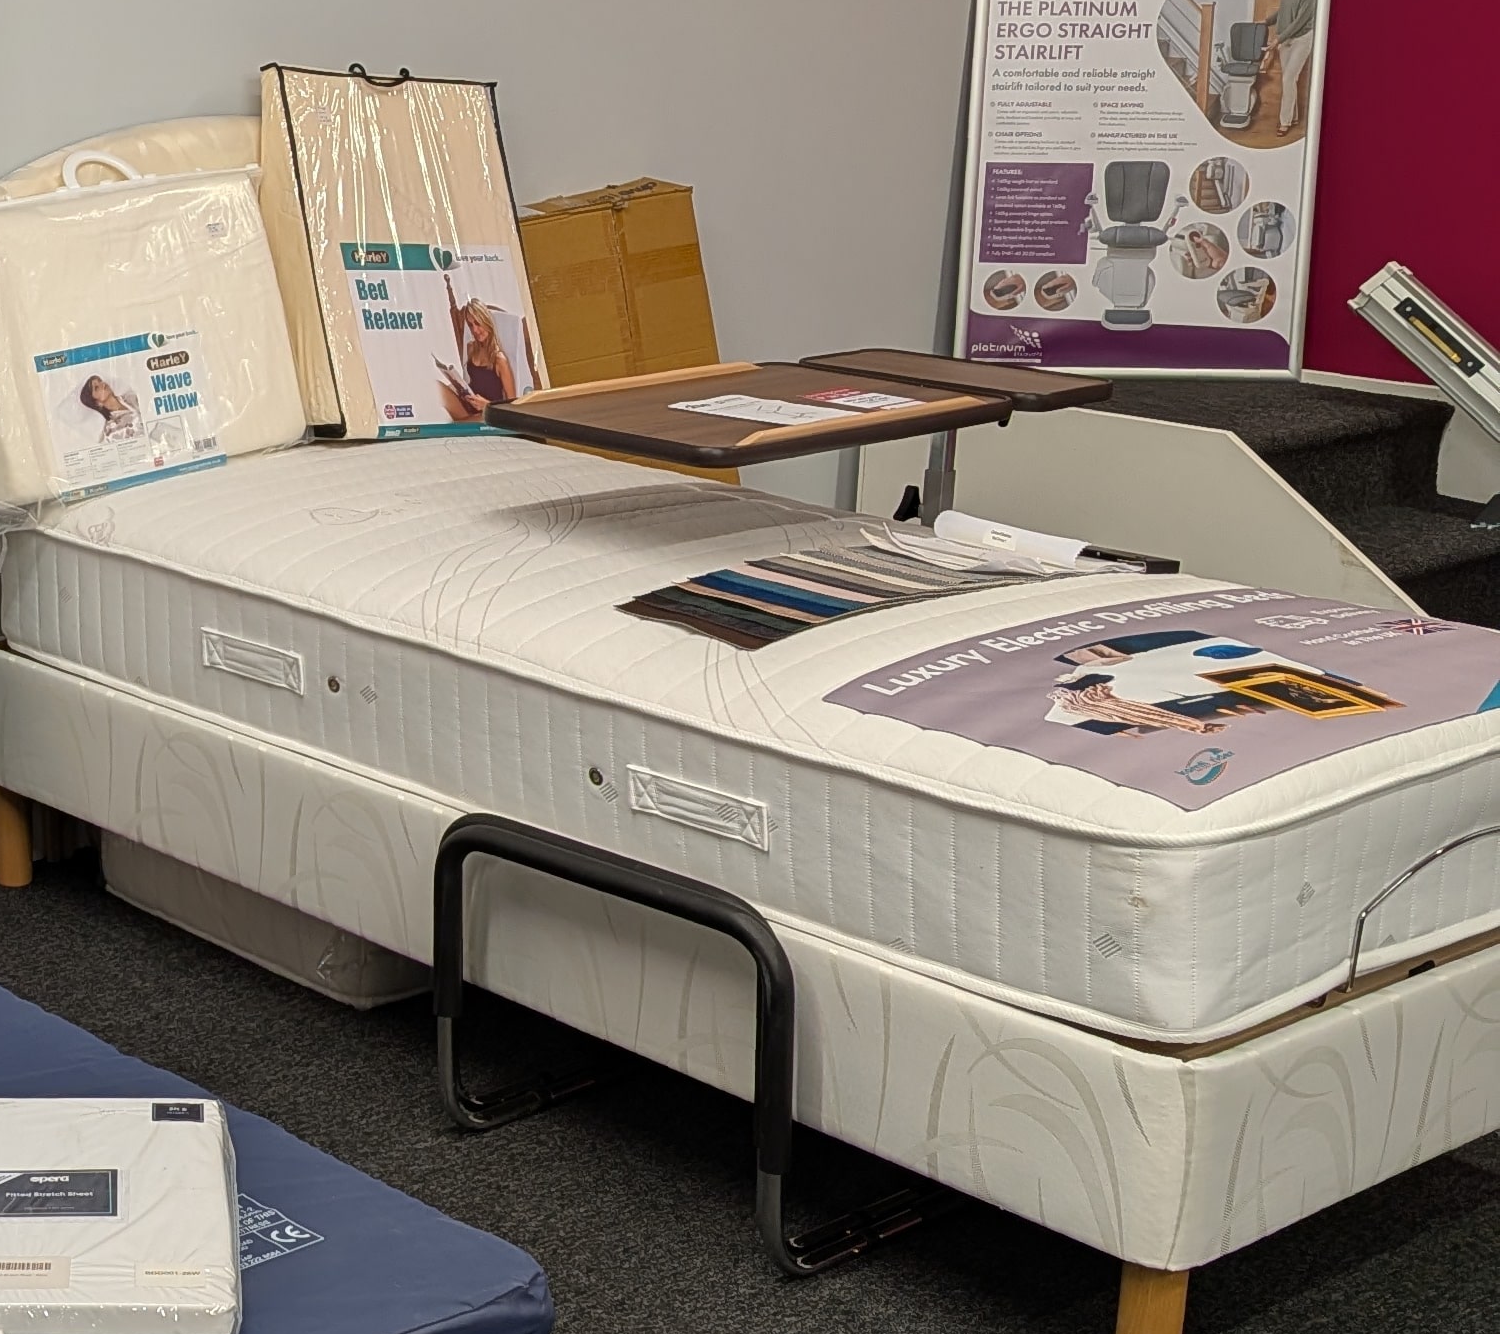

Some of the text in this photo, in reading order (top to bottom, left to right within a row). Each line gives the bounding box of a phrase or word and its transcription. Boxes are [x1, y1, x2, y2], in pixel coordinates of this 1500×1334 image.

[997, 0, 1138, 17] THE PLATINUM
[996, 22, 1152, 40] ERGO STRAIGHT
[994, 44, 1084, 61] STAIRLIFT
[992, 68, 1156, 82] A comfortable and reliable straight
[991, 81, 1148, 96] stairlift tailored to suit your needs.
[355, 279, 389, 302] Bed
[362, 308, 424, 331] Relaxer
[971, 342, 1026, 354] platinum
[150, 372, 192, 393] Wave
[153, 392, 198, 415] Pillow
[861, 589, 1298, 697] Luxury Electric Profiling Beds
[30, 1175, 70, 1184] opera
[270, 1224, 311, 1243] CE
